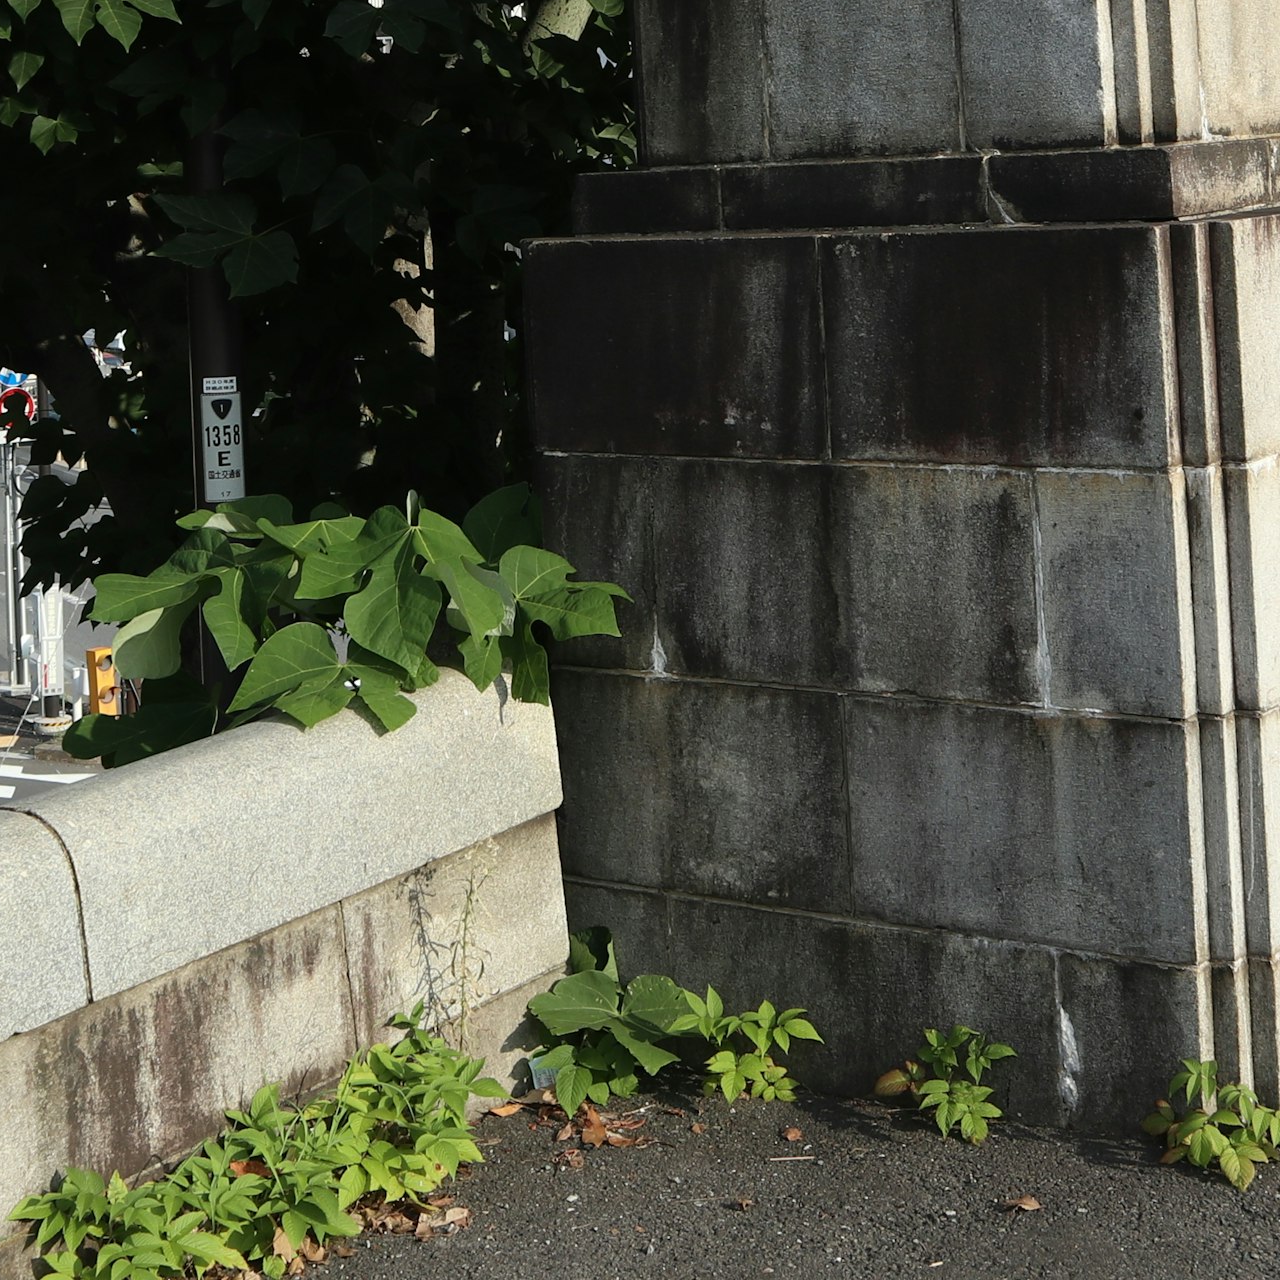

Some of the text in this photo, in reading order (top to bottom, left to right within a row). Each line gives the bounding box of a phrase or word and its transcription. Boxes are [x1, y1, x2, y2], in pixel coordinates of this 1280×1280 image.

[205, 424, 241, 447] 1358
[218, 451, 232, 466] E
[208, 469, 241, 480] 国土交通省
